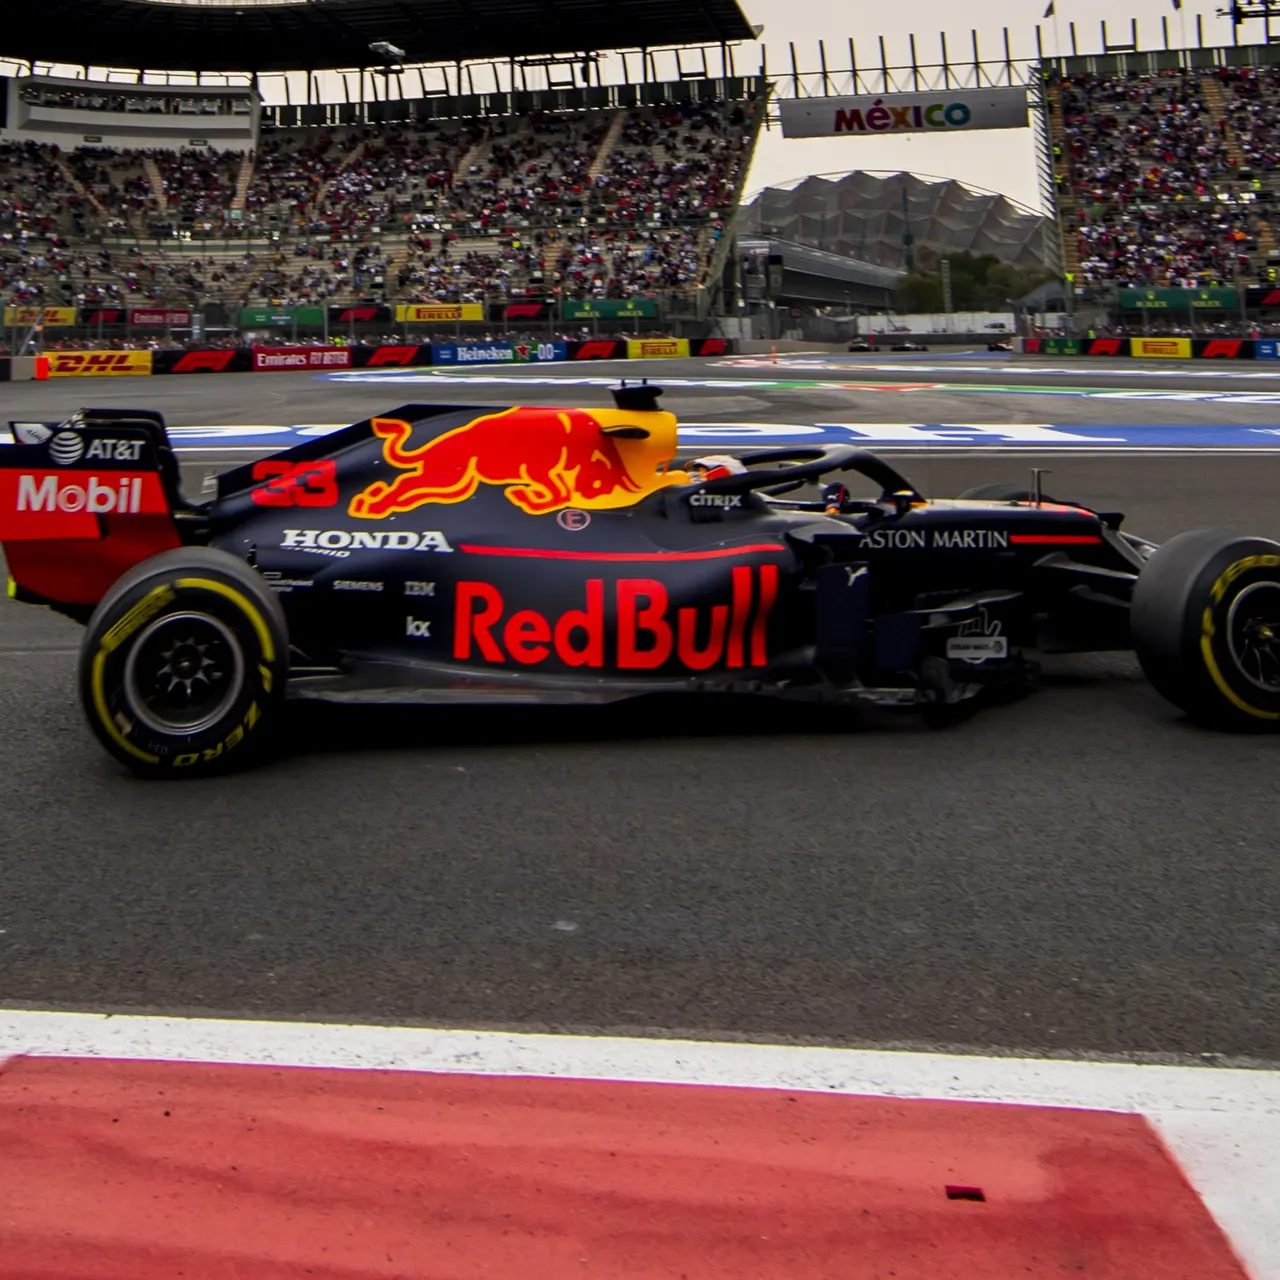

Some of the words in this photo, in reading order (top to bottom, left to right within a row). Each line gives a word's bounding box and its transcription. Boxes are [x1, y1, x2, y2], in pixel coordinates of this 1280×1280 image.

[55, 354, 133, 372] DHL
[257, 352, 308, 367] Emirates
[457, 346, 513, 362] Heineken
[84, 438, 147, 460] AT&T
[16, 474, 143, 514] Mobil
[280, 529, 454, 553] HONDA
[858, 529, 926, 549] ASTON
[932, 529, 1009, 549] MARTIN
[332, 579, 385, 592] SIEMENS
[403, 580, 436, 597] IBM
[453, 578, 604, 667] Red
[616, 564, 778, 670] Bull
